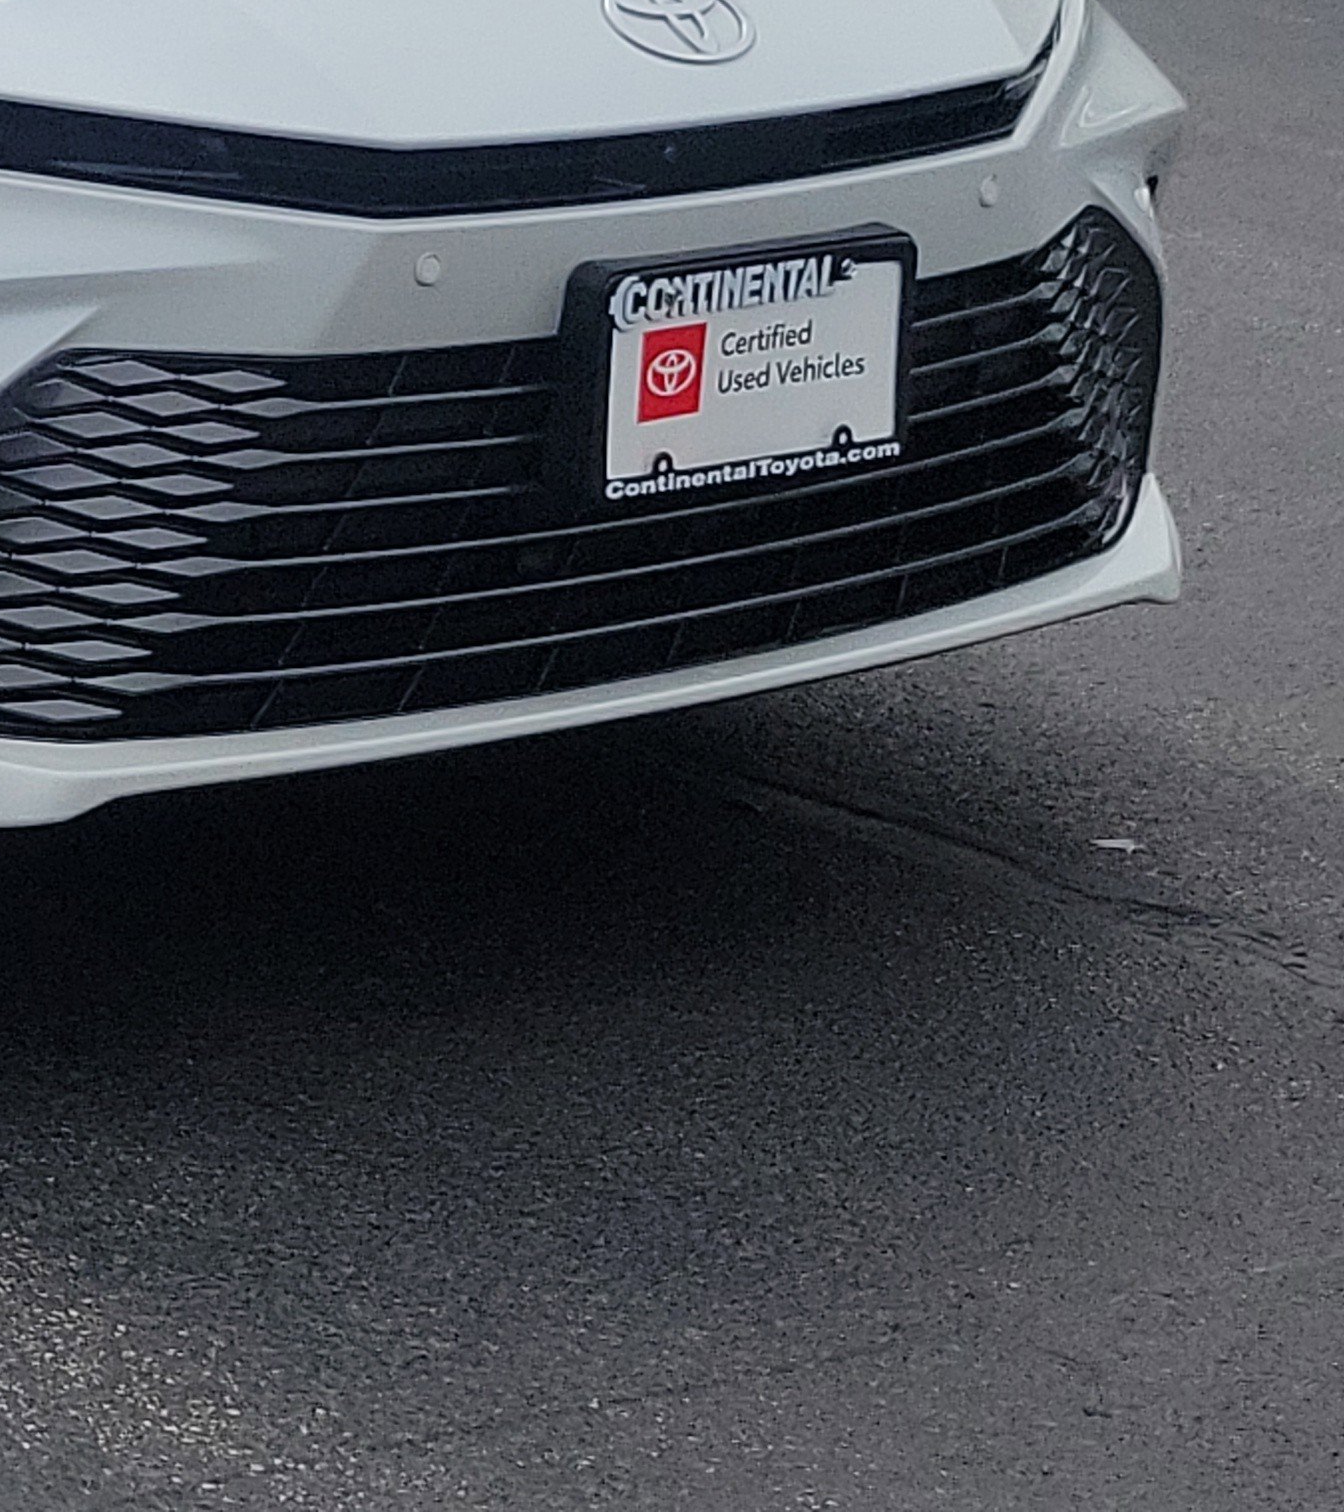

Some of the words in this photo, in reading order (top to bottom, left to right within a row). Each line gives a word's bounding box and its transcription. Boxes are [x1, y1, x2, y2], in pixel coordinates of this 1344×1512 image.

[610, 254, 835, 330] CONTINENTAL
[720, 320, 812, 356] Certified
[717, 364, 770, 394] Used
[776, 354, 865, 385] Vehicles
[605, 441, 900, 500] ContinentalToyota.com
